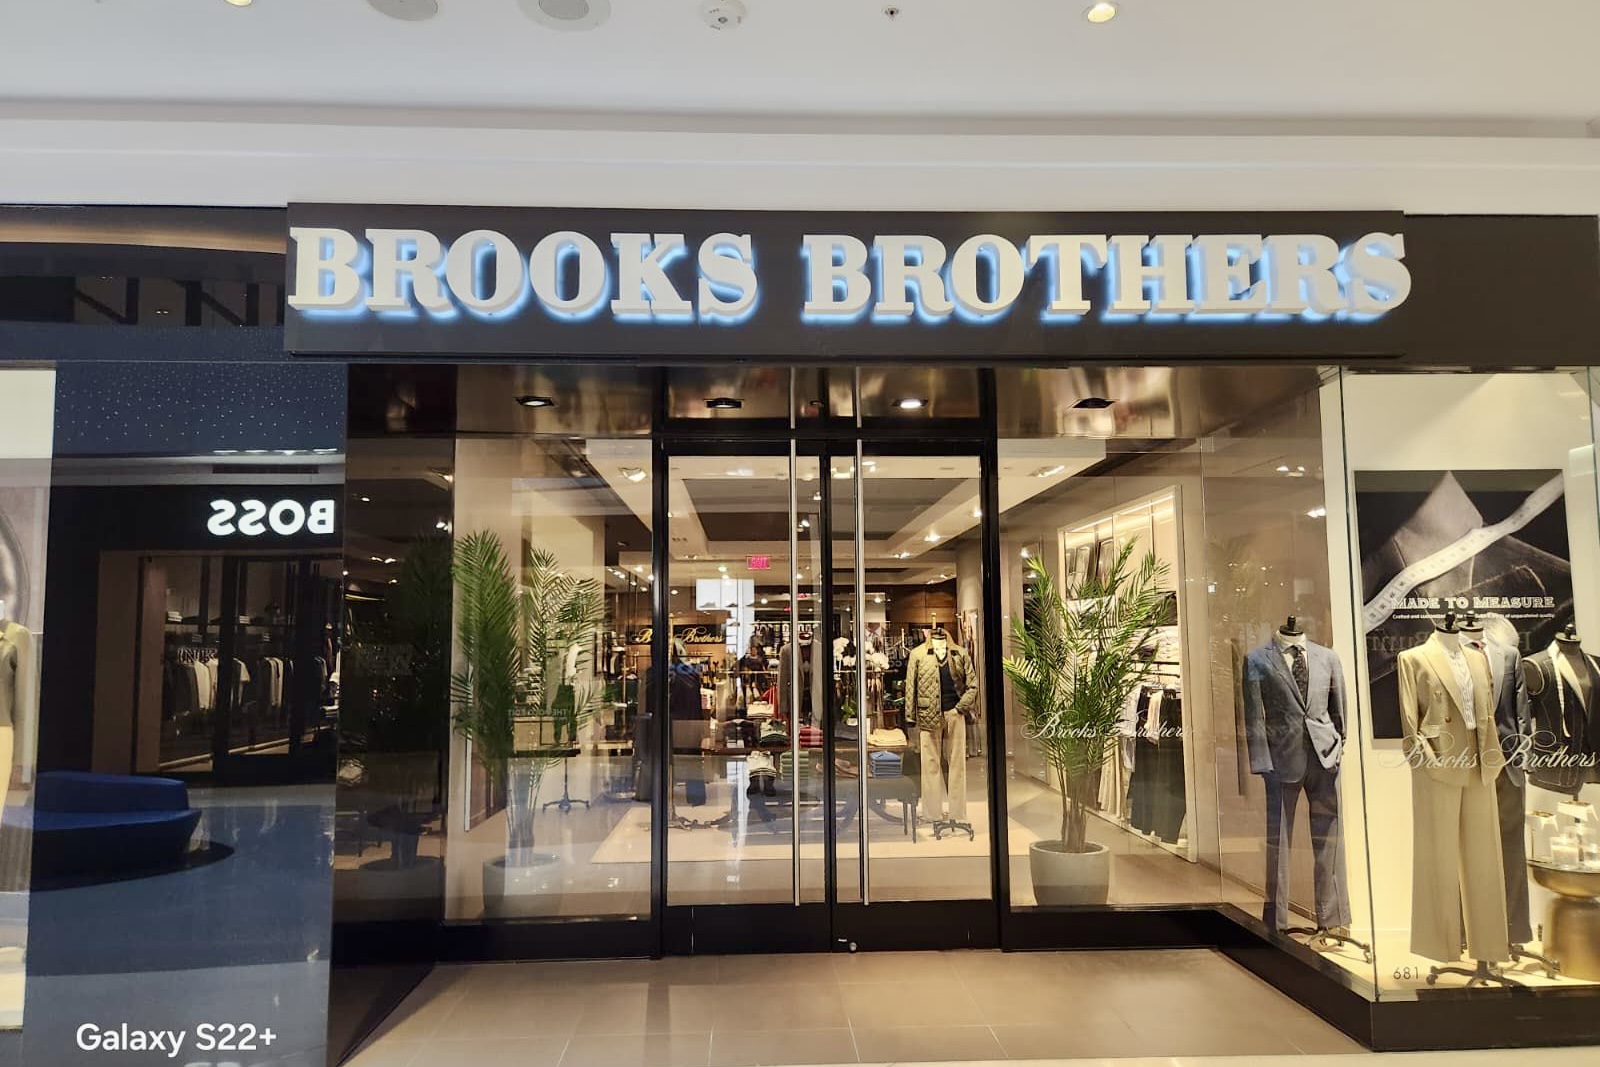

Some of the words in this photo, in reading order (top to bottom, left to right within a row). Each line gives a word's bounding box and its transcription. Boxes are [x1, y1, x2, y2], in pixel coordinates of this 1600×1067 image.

[287, 226, 760, 321] BROOKS
[801, 231, 1412, 320] BROTHERS
[1391, 597, 1440, 609] MADE
[1444, 597, 1468, 609] TO
[1473, 596, 1555, 609] MEASURE
[675, 626, 723, 643] Brothers
[1020, 709, 1097, 739] Brooks
[1379, 731, 1478, 768] Brooks
[1482, 730, 1597, 768] Brothers
[1393, 966, 1419, 980] 681
